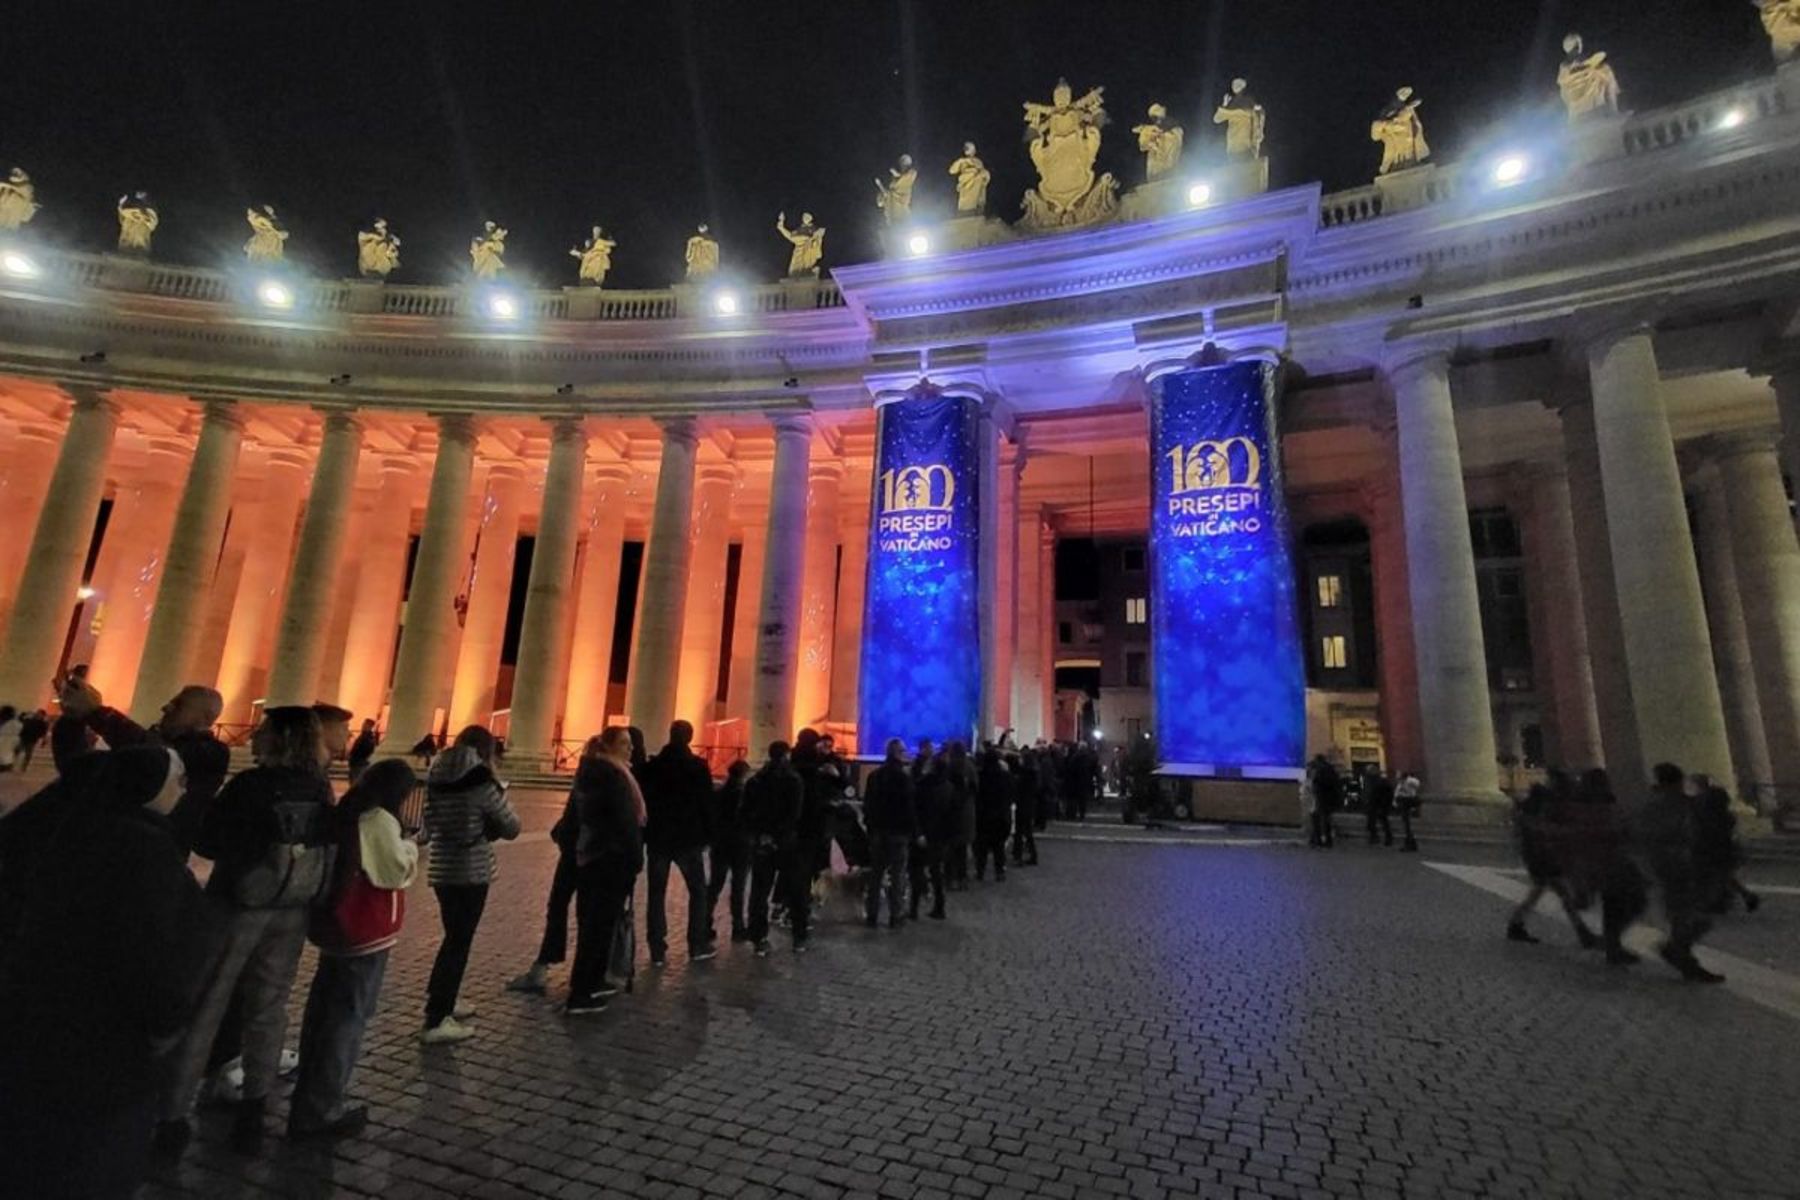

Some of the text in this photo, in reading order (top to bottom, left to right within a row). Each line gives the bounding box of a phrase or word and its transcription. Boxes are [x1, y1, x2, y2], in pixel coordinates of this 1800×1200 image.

[1166, 436, 1260, 495] 100
[881, 464, 955, 513] 100
[1169, 492, 1259, 517] PRESEPI
[880, 514, 952, 533] PRESEPI
[1170, 517, 1261, 538] VATICANO
[880, 537, 952, 552] VATICANO
